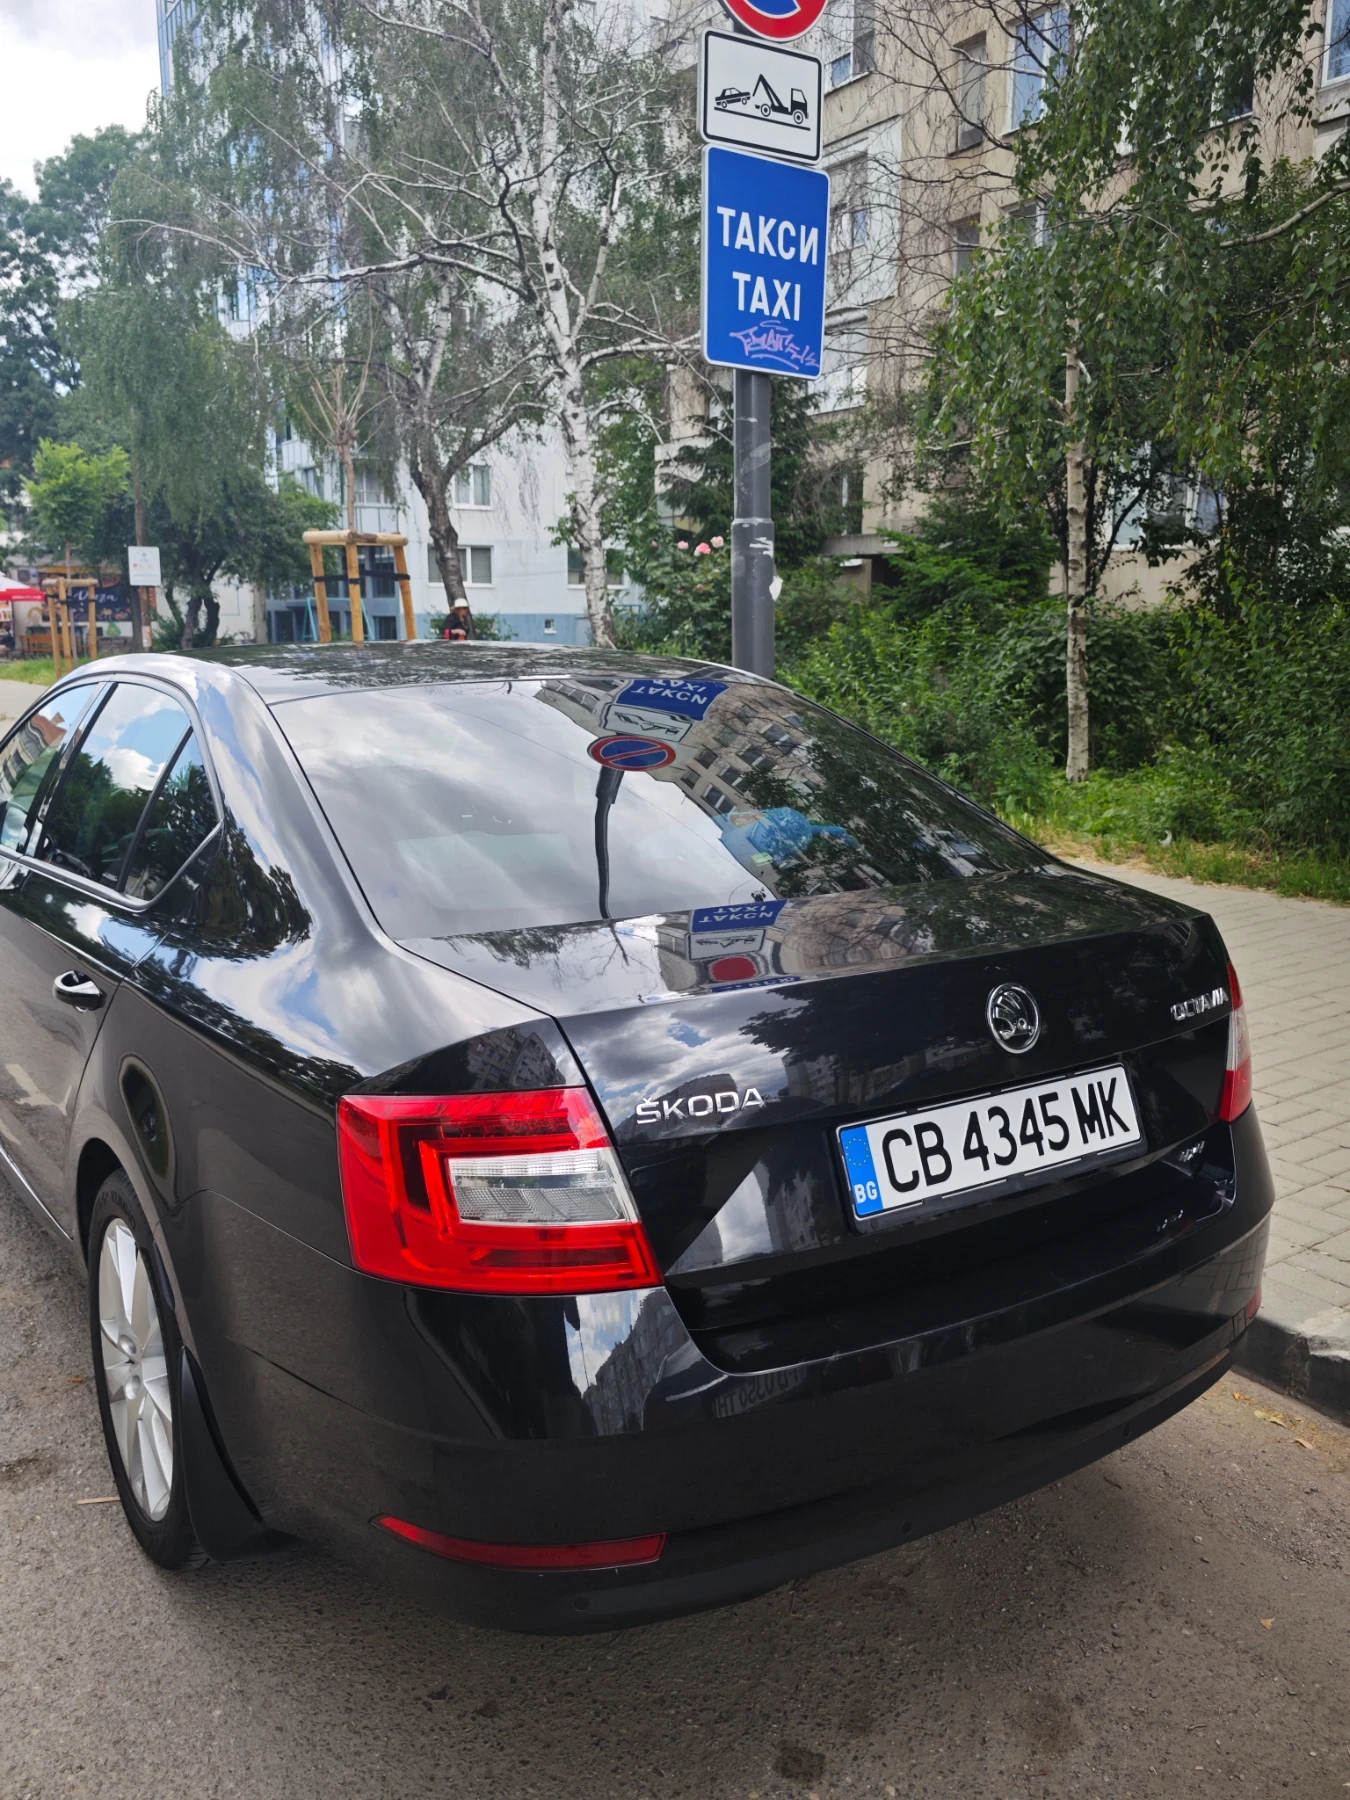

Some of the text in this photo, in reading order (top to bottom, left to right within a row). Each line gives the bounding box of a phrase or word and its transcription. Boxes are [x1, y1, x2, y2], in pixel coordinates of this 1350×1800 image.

[716, 205, 819, 266] ТАКСИ
[732, 271, 801, 322] TAXI
[636, 1087, 767, 1125] ŠKODA
[881, 1077, 1131, 1194] CB 4345 MK
[853, 1181, 878, 1204] BG
